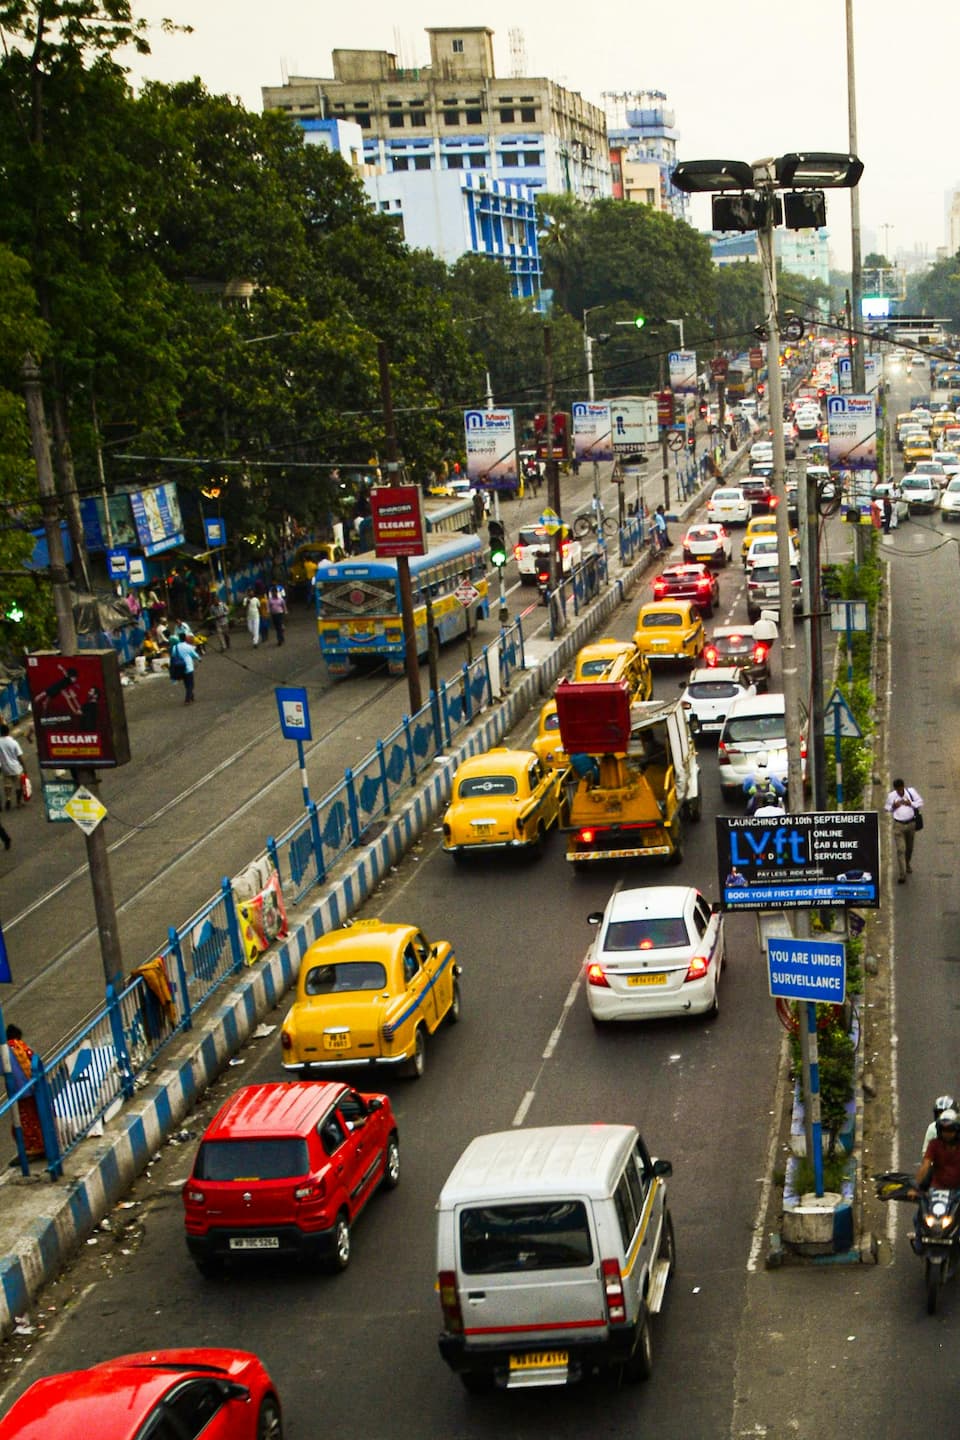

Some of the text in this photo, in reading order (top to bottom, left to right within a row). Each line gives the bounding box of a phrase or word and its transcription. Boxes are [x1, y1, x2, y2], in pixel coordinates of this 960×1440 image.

[378, 521, 415, 529] ELEGANT
[50, 735, 99, 744] ELEGANT
[728, 815, 866, 827] LAUNCHING ON 10th SEPTEMBER
[813, 830, 843, 838] ONLINE
[814, 841, 831, 850] CAB
[840, 841, 859, 849] BIKE
[813, 852, 853, 861] SERVICES
[728, 891, 750, 899] BOOK
[752, 890, 773, 898] YOUR
[774, 889, 794, 897] FIRST
[814, 888, 832, 896] FREE
[770, 950, 842, 967] YOU ARE UNDER
[772, 972, 841, 989] SURVEILLANCE
